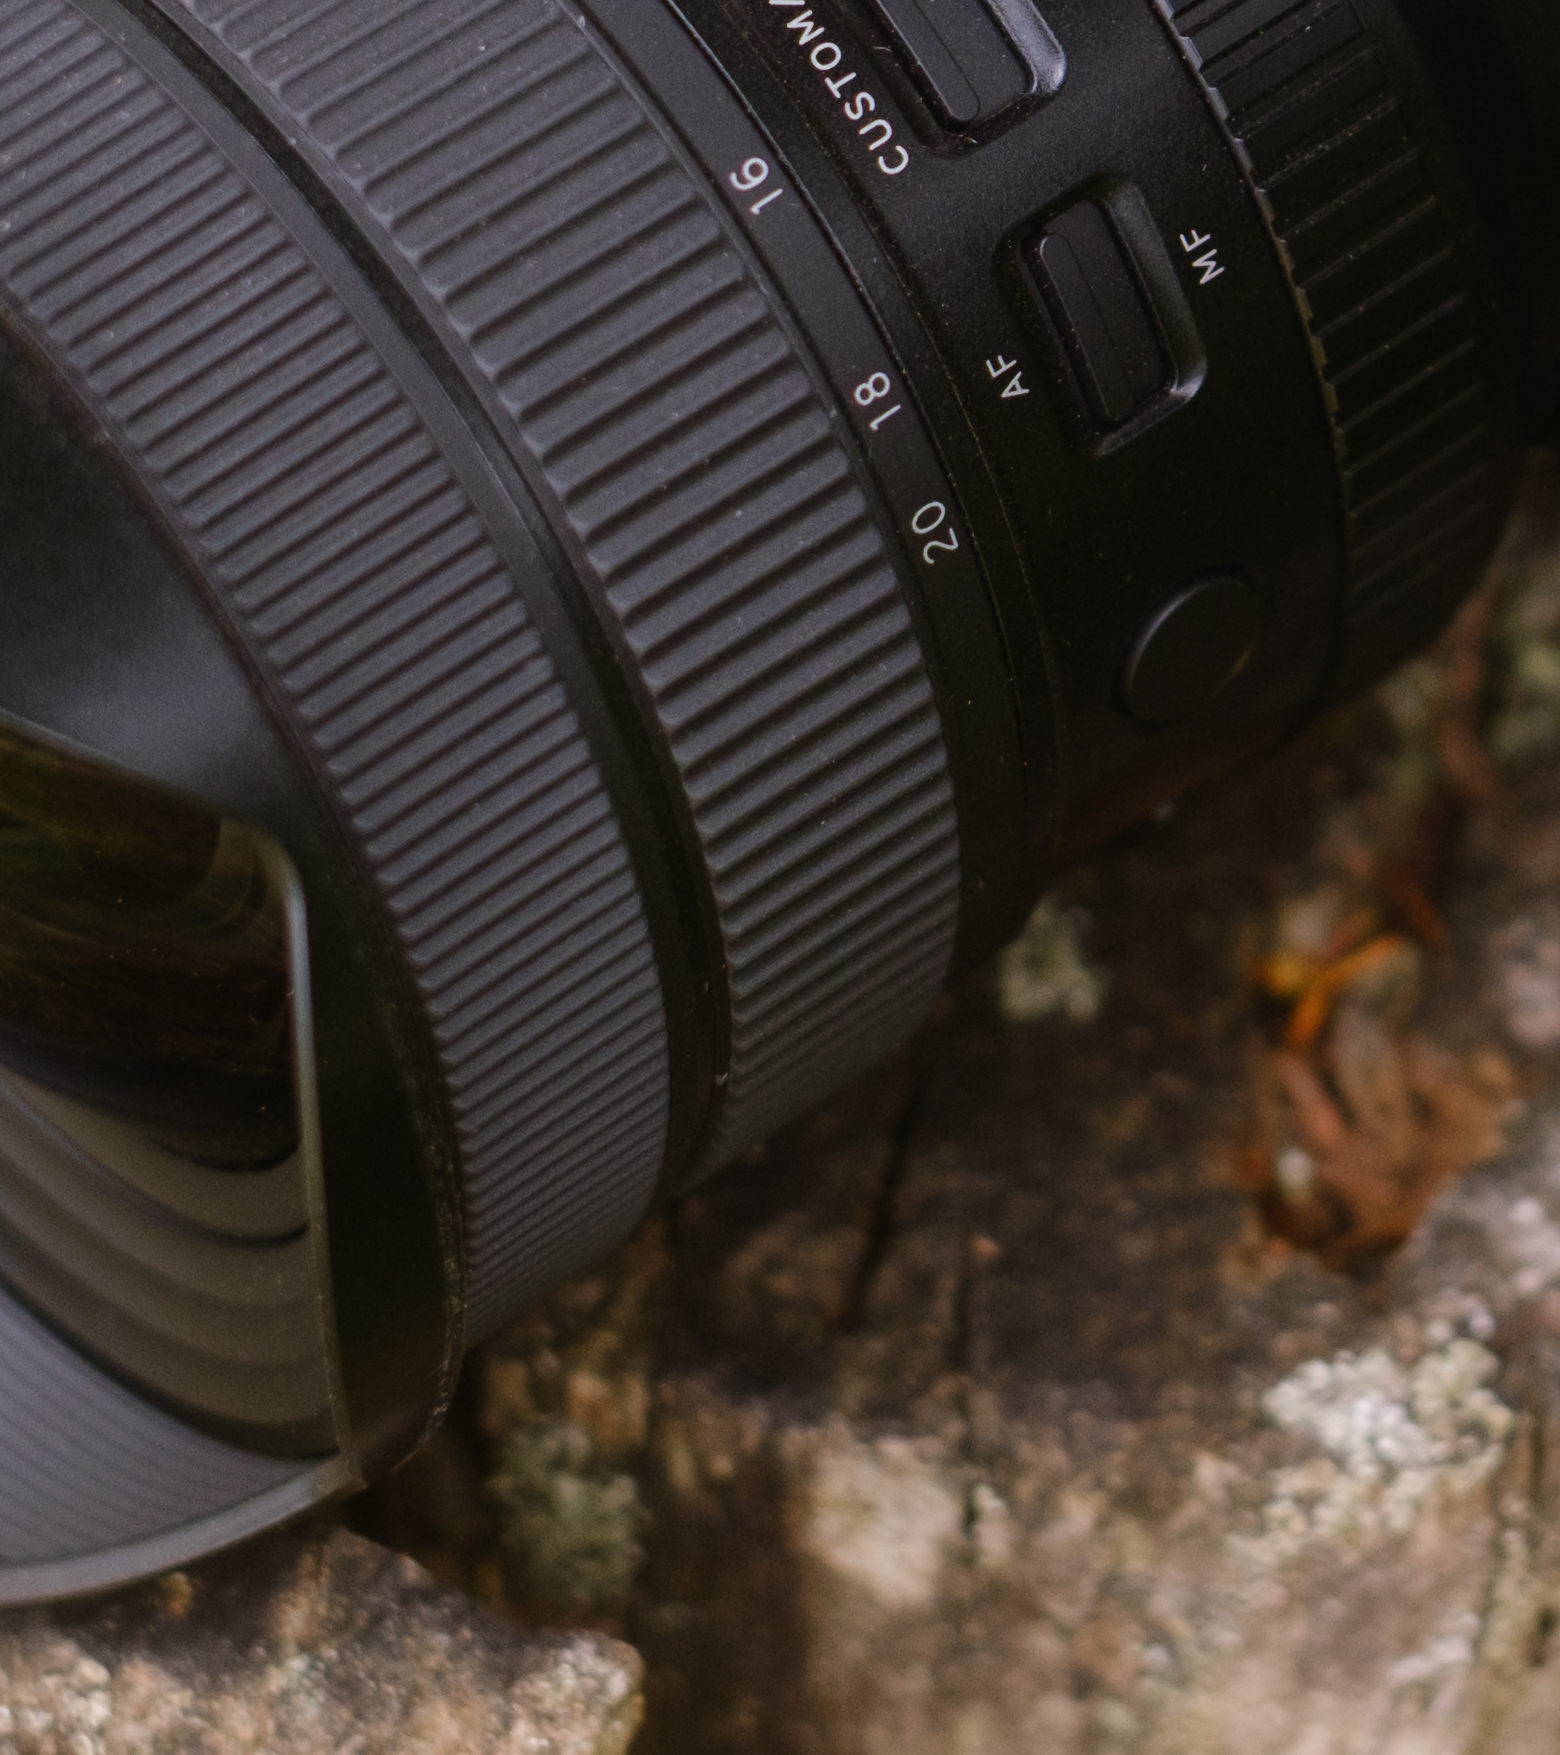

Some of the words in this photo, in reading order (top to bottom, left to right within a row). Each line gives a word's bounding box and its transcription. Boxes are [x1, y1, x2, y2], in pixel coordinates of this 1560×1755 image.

[728, 156, 784, 216] 16
[1179, 227, 1226, 285] MF
[853, 371, 902, 432] 18
[985, 352, 1030, 401] AF
[911, 501, 959, 565] 20
